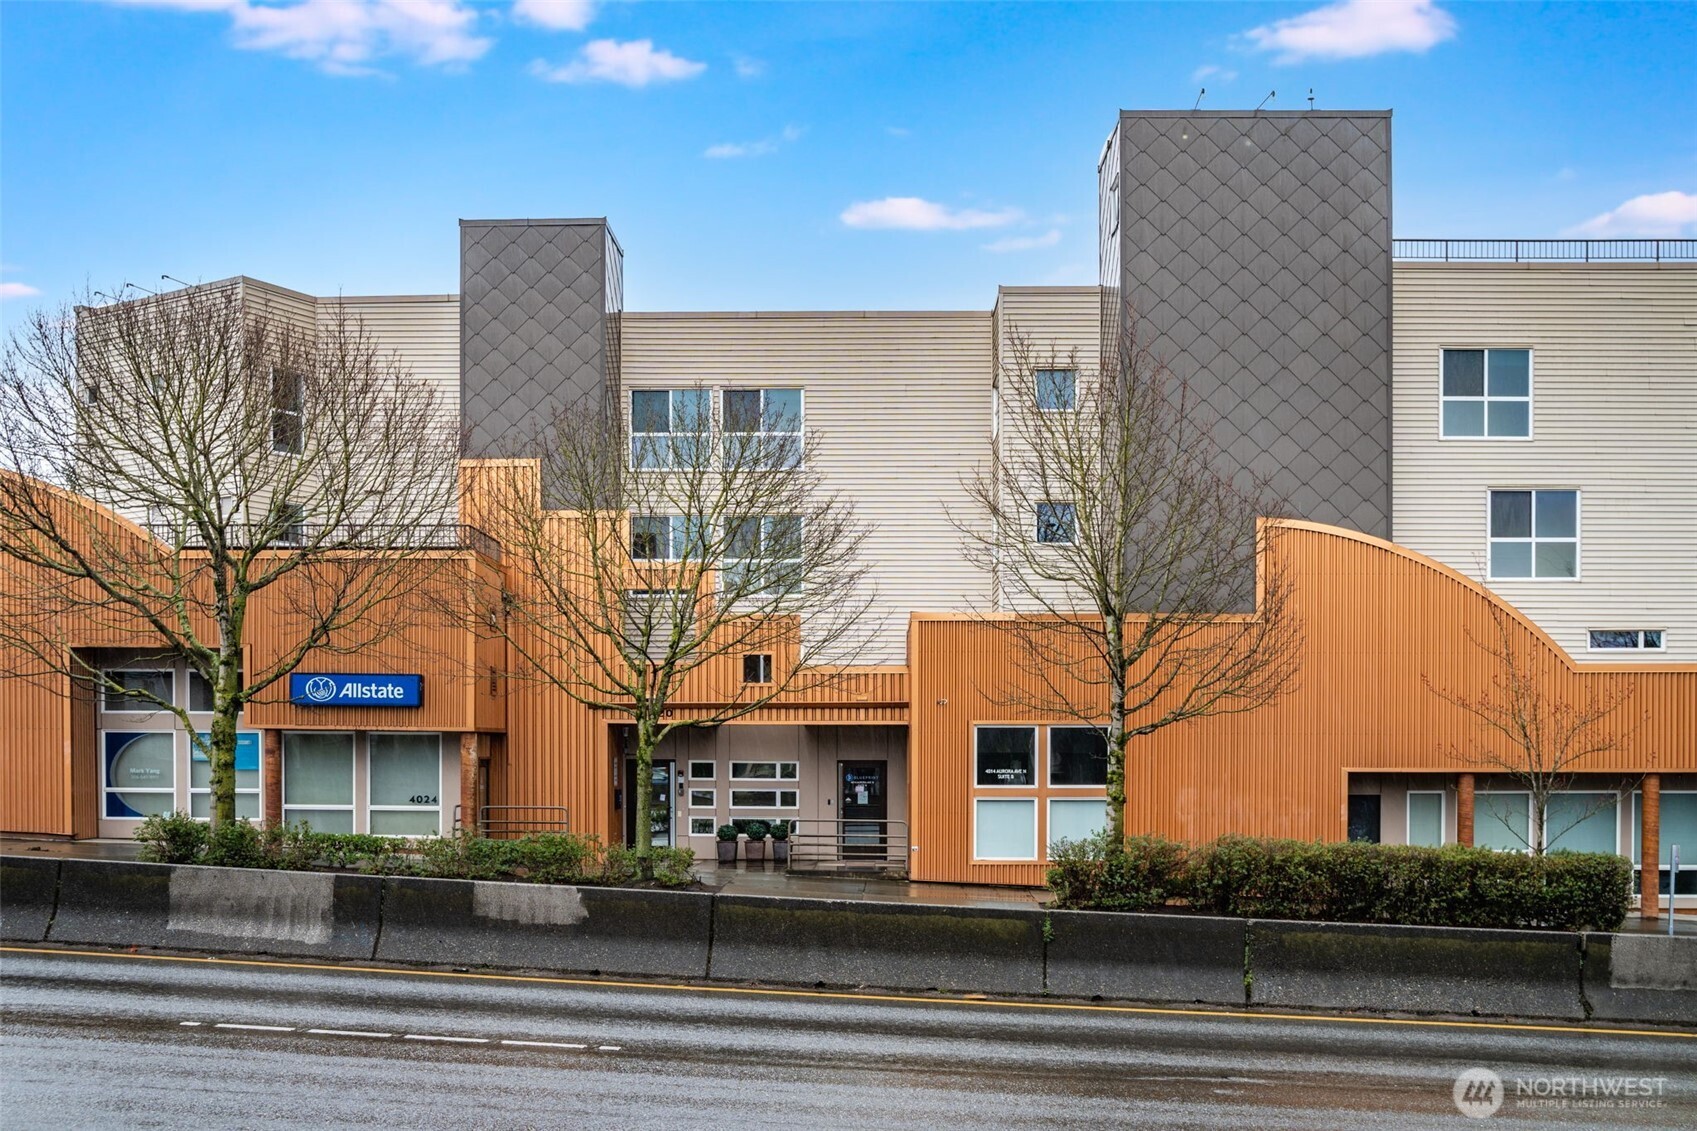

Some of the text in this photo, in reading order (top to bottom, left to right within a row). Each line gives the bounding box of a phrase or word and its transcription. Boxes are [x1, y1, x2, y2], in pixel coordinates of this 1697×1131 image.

[339, 682, 404, 699] Allstate
[145, 767, 160, 775] Yang
[409, 795, 437, 804] 4024
